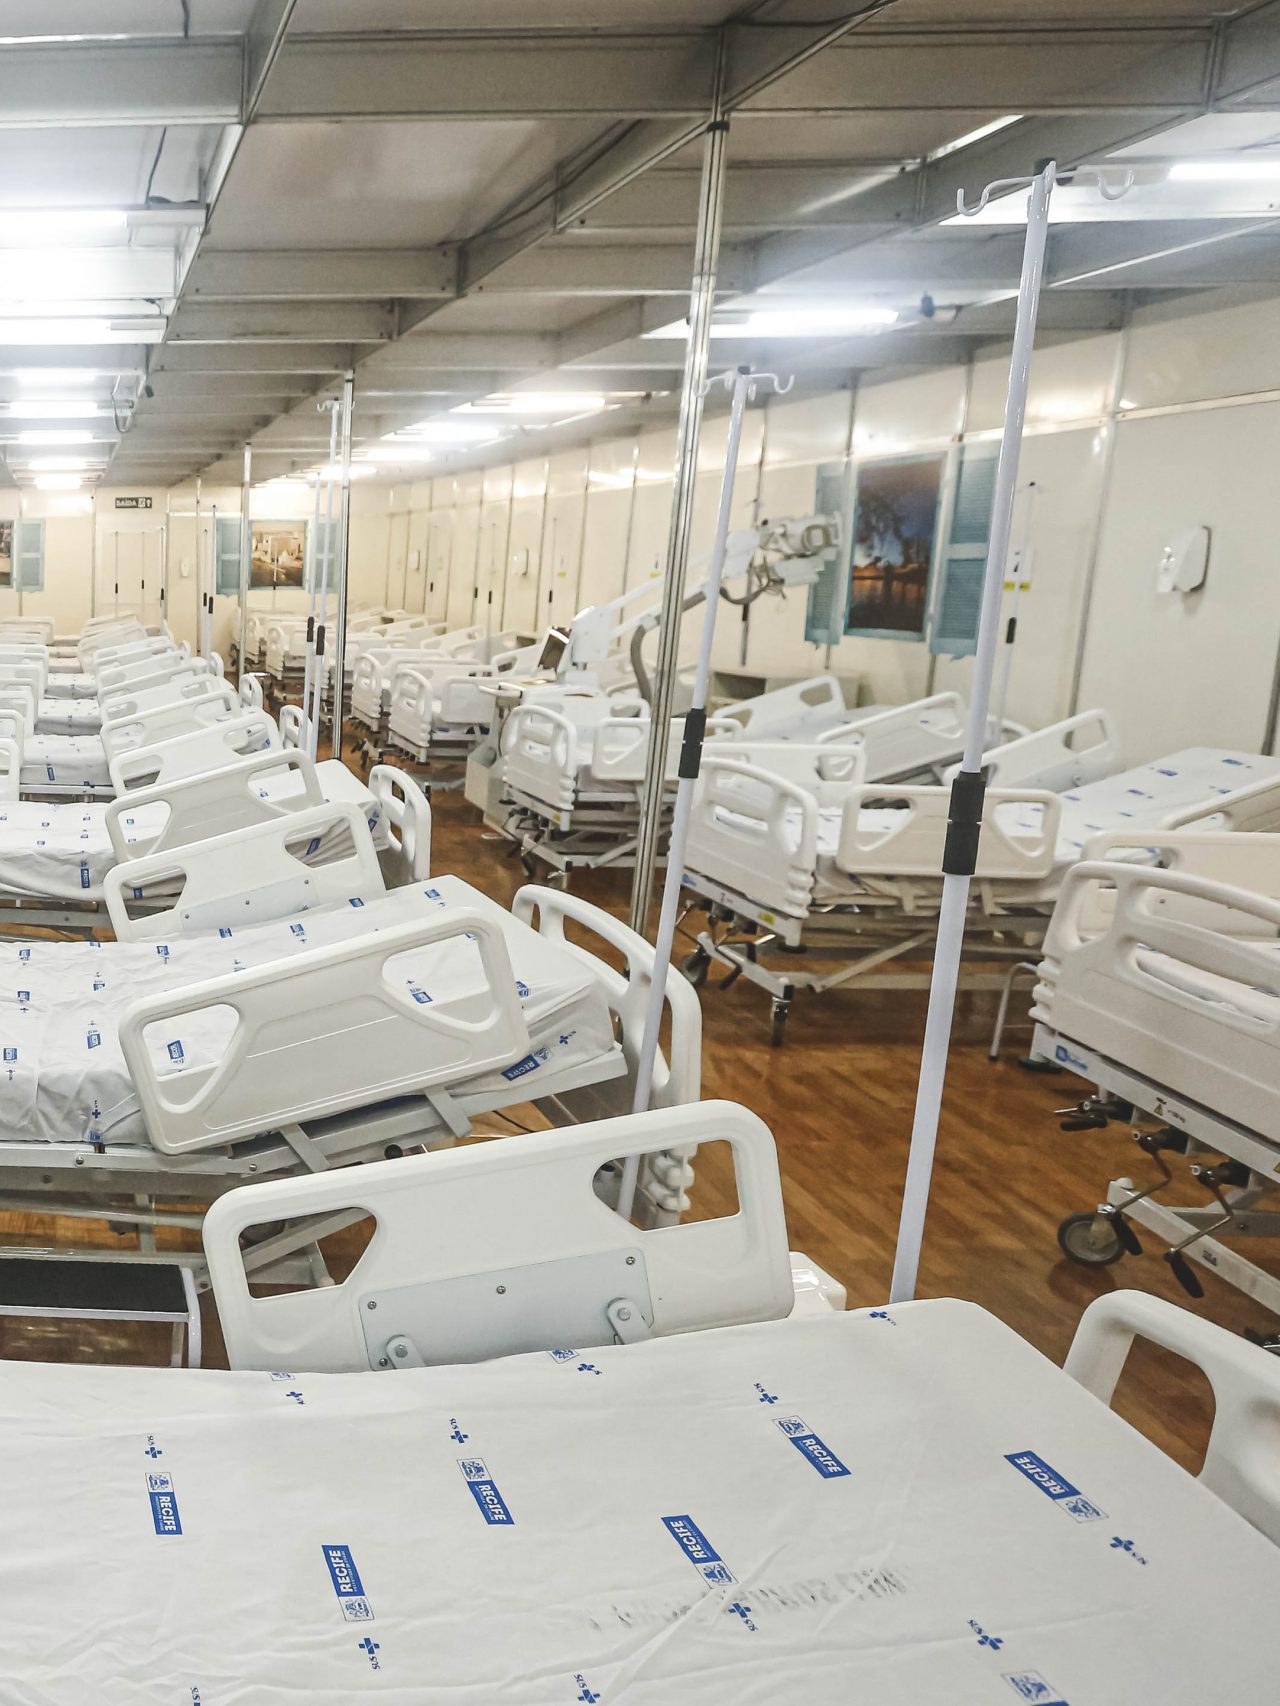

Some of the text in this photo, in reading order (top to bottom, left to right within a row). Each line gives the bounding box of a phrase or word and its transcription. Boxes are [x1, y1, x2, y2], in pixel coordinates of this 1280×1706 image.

[802, 1439, 842, 1473] RECIFE
[1015, 1456, 1065, 1495] RECIFE
[158, 1496, 177, 1531] RECIFE
[479, 1485, 507, 1521] RECIFE
[670, 1520, 707, 1559] RECIFE
[328, 1550, 354, 1593] RECIFE
